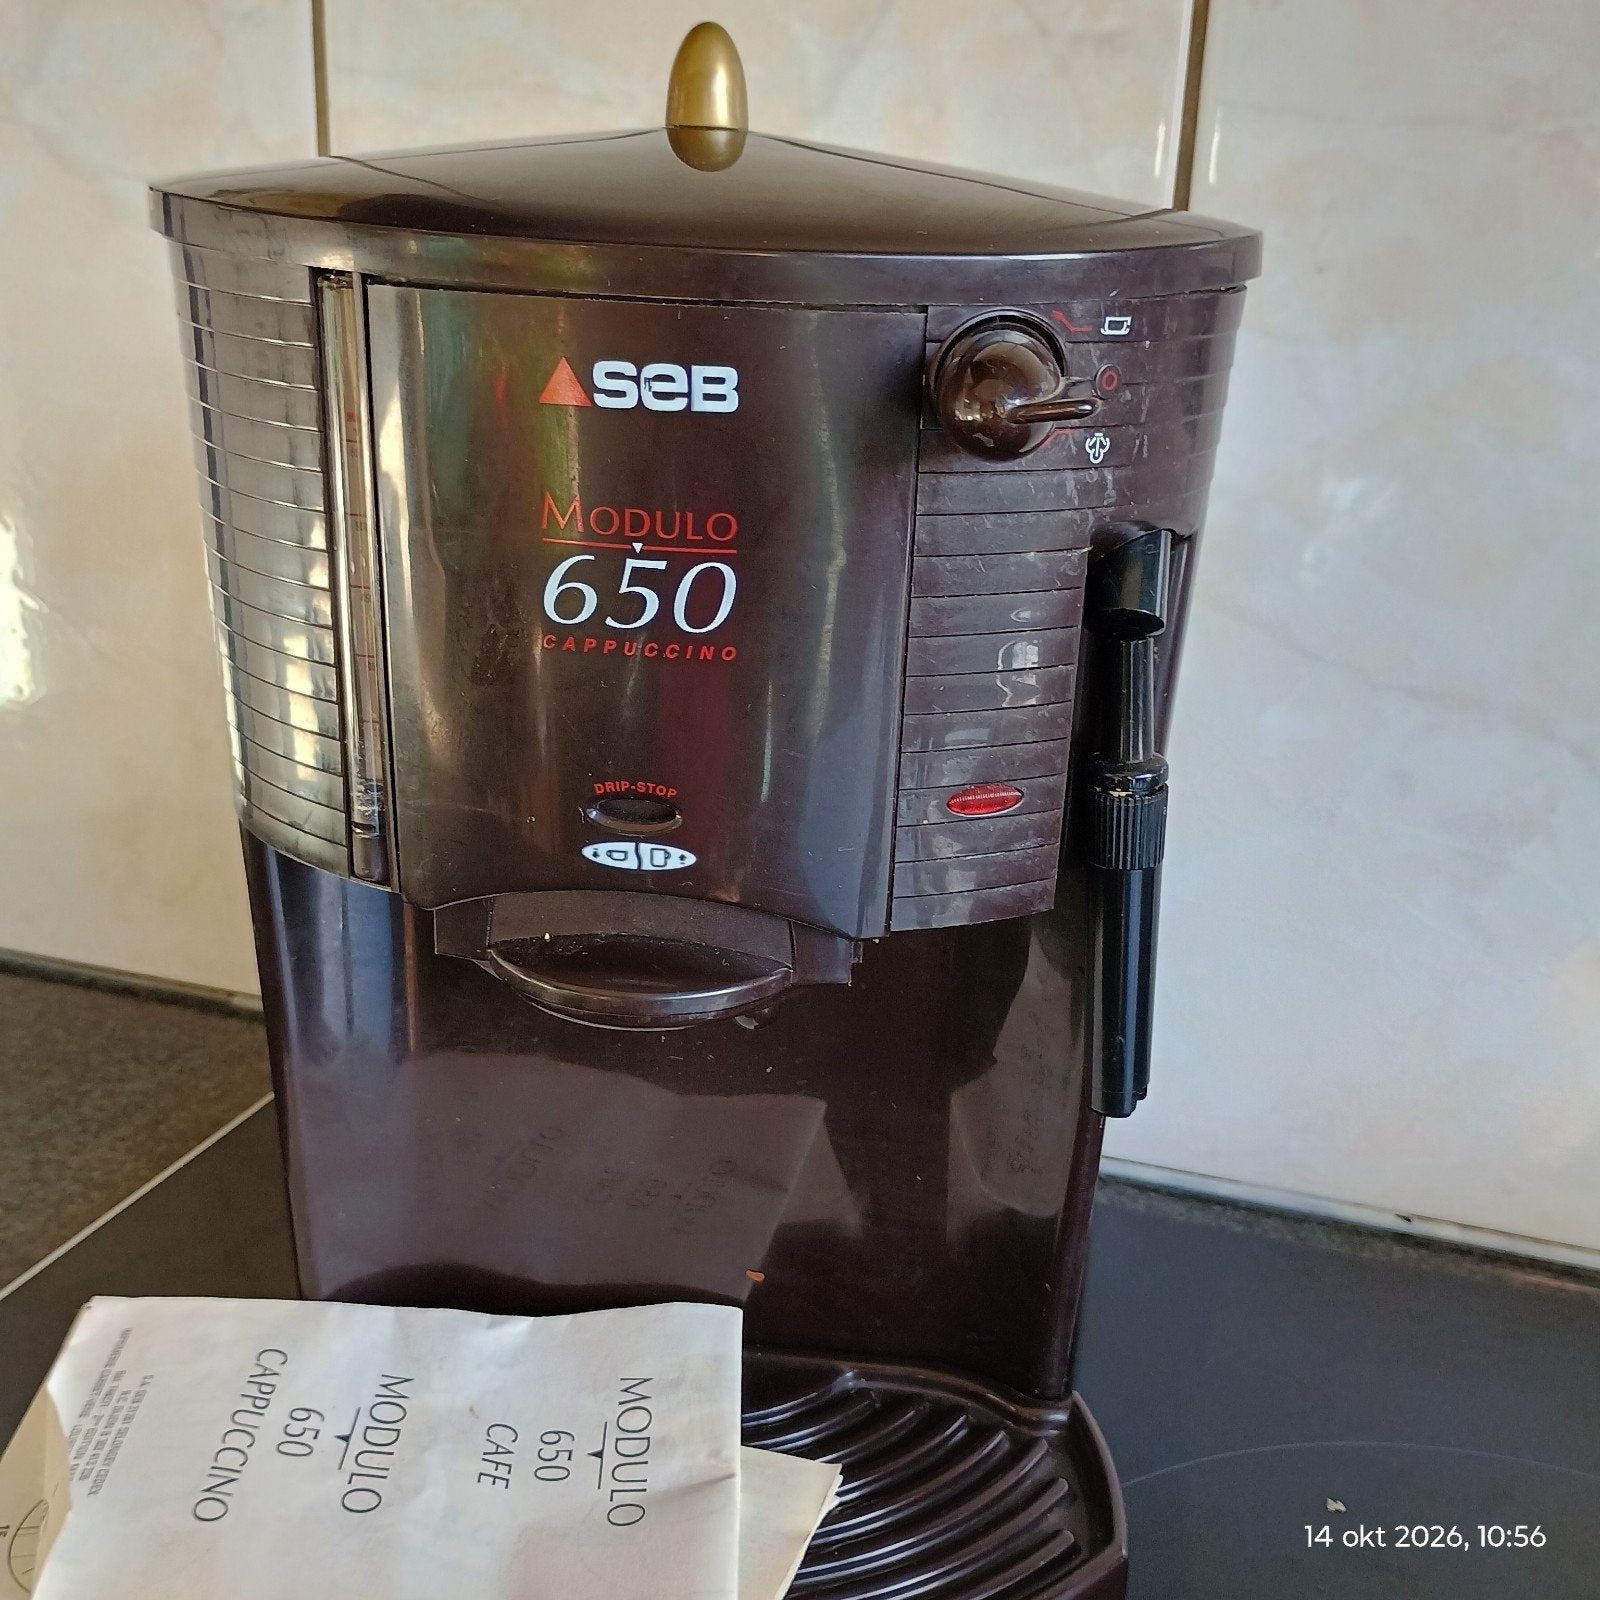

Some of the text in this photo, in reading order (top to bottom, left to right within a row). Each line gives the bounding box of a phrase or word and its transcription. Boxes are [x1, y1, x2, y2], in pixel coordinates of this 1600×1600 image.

[541, 491, 738, 542] MODULO
[543, 554, 738, 634] 650
[542, 634, 738, 661] CAPPUCCINO
[593, 780, 678, 798] DRIP-STOP
[193, 1348, 288, 1522] CAPPUCCINO
[275, 1407, 325, 1457] 650
[341, 1373, 415, 1514] MODULO
[477, 1423, 519, 1489] CAFE
[533, 1430, 575, 1482] 650
[607, 1377, 654, 1527] MODULO
